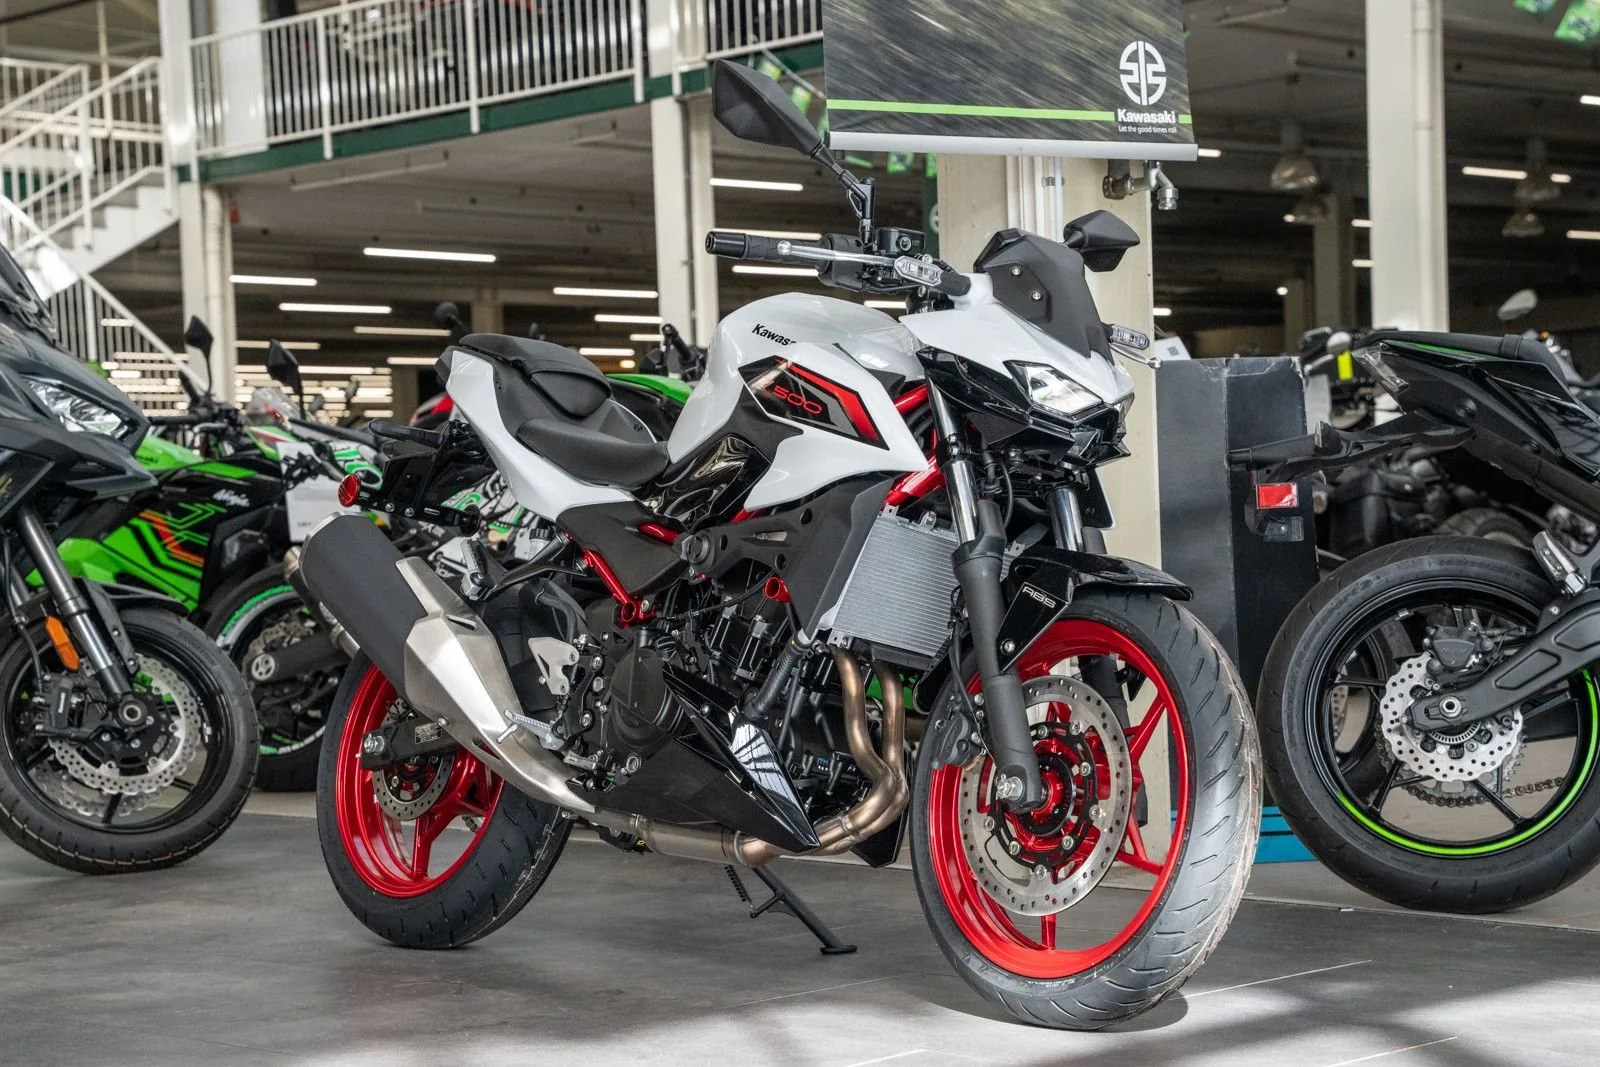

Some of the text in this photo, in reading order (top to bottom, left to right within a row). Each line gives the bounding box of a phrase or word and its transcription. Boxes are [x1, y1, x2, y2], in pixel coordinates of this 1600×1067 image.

[1117, 108, 1176, 123] Kawasaki
[1137, 126, 1152, 134] good
[752, 323, 797, 346] Kawas
[1022, 586, 1056, 608] ABS
